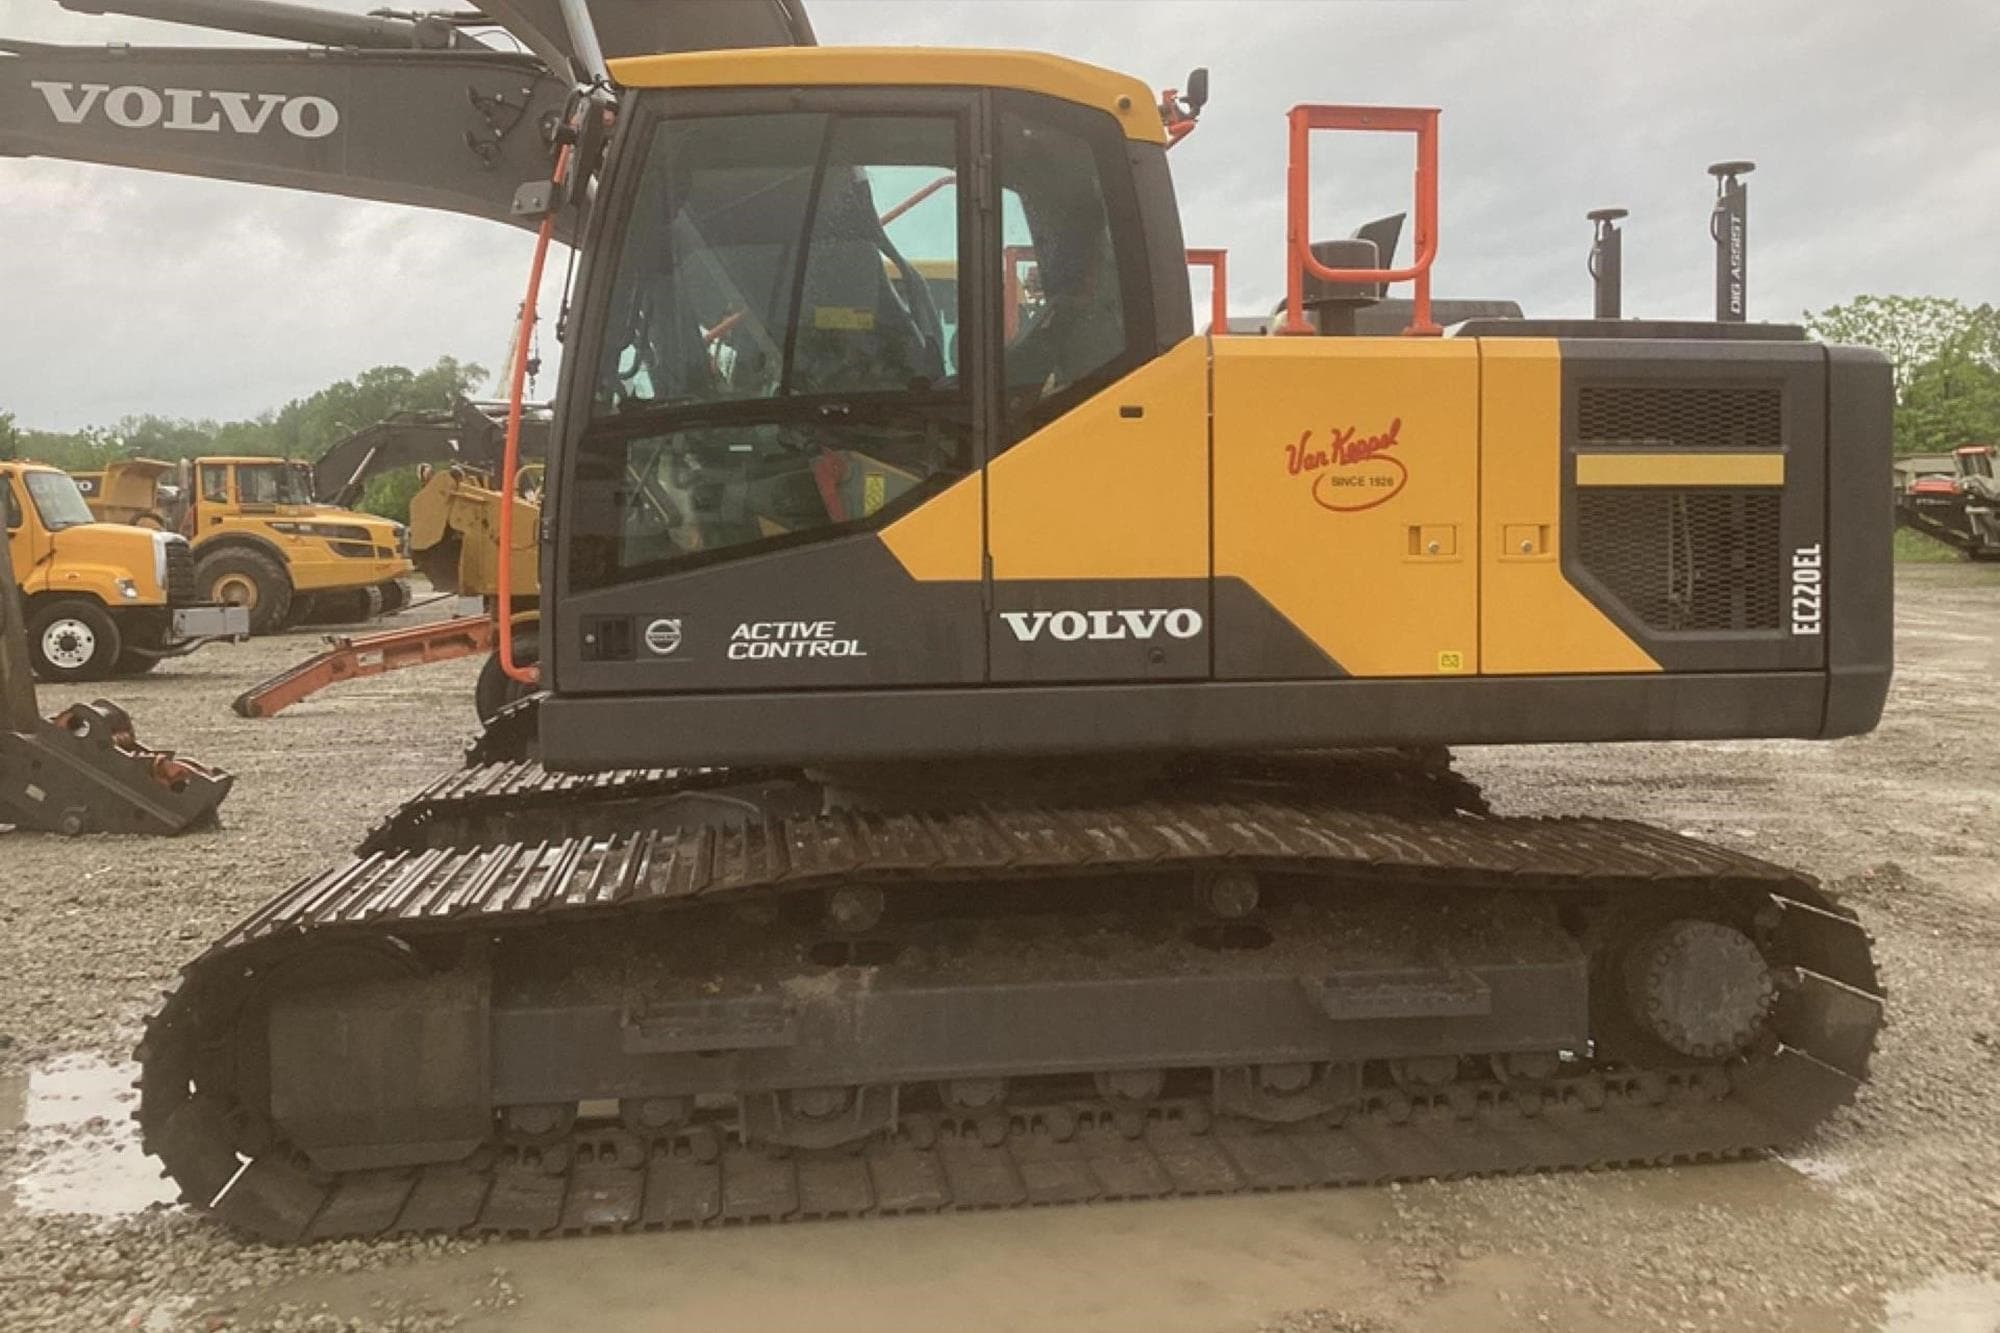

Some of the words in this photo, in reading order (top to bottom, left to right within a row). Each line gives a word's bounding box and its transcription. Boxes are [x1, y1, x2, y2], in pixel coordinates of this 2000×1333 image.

[31, 79, 339, 137] VOLVO
[1730, 213, 1741, 280] ASSIST
[1730, 283, 1741, 314] DIG
[1285, 430, 1329, 475] Van
[1331, 476, 1366, 487] SINCE
[1792, 543, 1822, 635] EC220EL
[731, 621, 836, 640] ACTIVE
[1000, 608, 1203, 641] VOLVO
[728, 640, 867, 660] CONTROL
